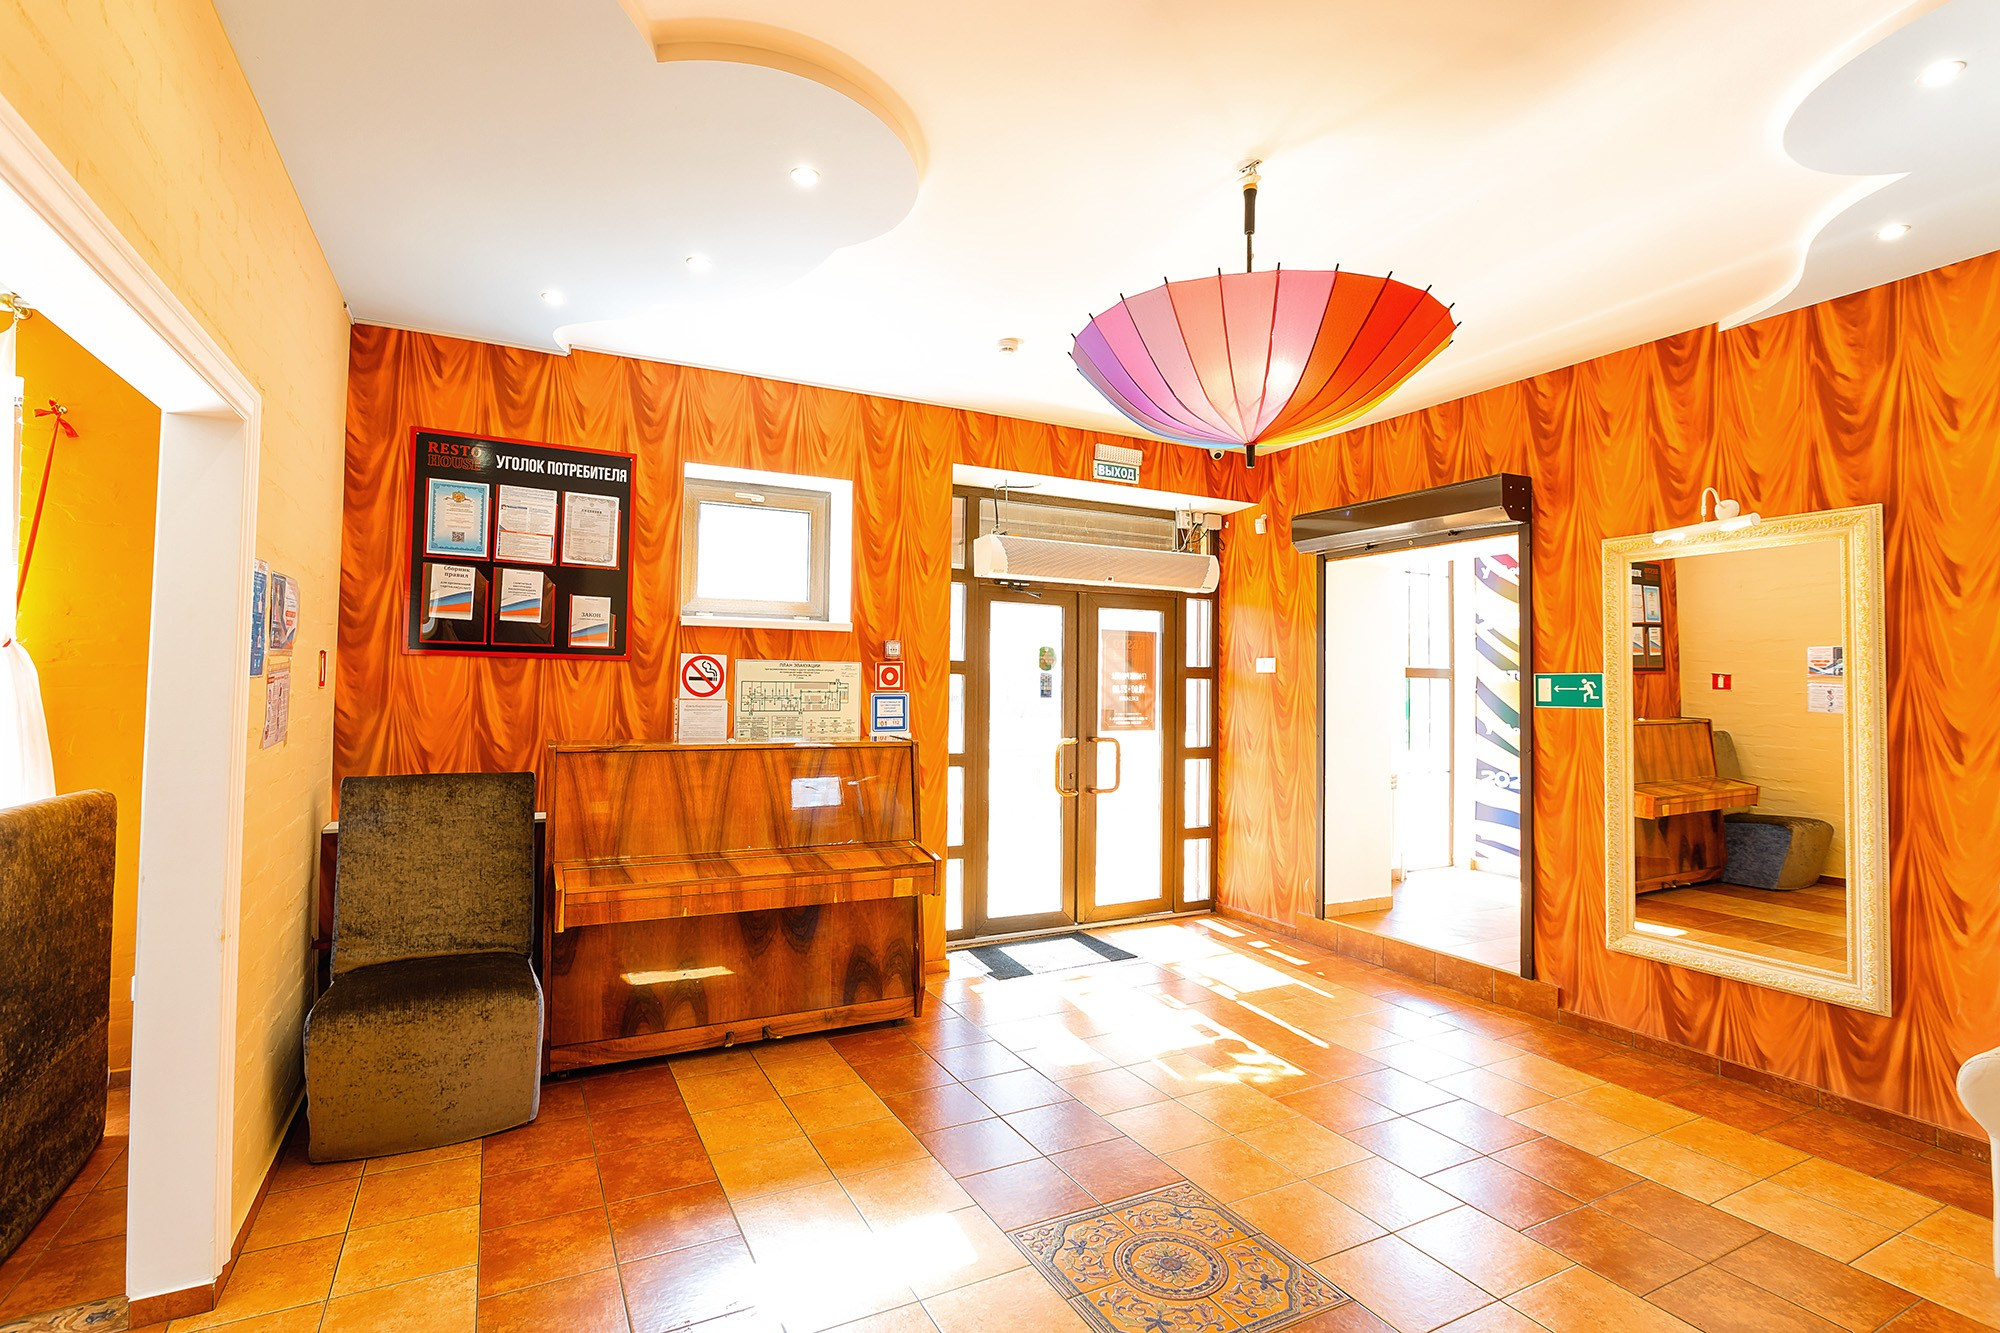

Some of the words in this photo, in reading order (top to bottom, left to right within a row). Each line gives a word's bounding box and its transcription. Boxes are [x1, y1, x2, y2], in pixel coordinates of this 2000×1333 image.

[428, 441, 482, 458] RESTO
[427, 454, 481, 471] HOUSE
[496, 455, 545, 475] УГОЛОК
[547, 460, 627, 483] ПОТРЕБИТЕЛЯ
[1098, 464, 1135, 480] ВЫХОД
[443, 565, 471, 573] Сборник
